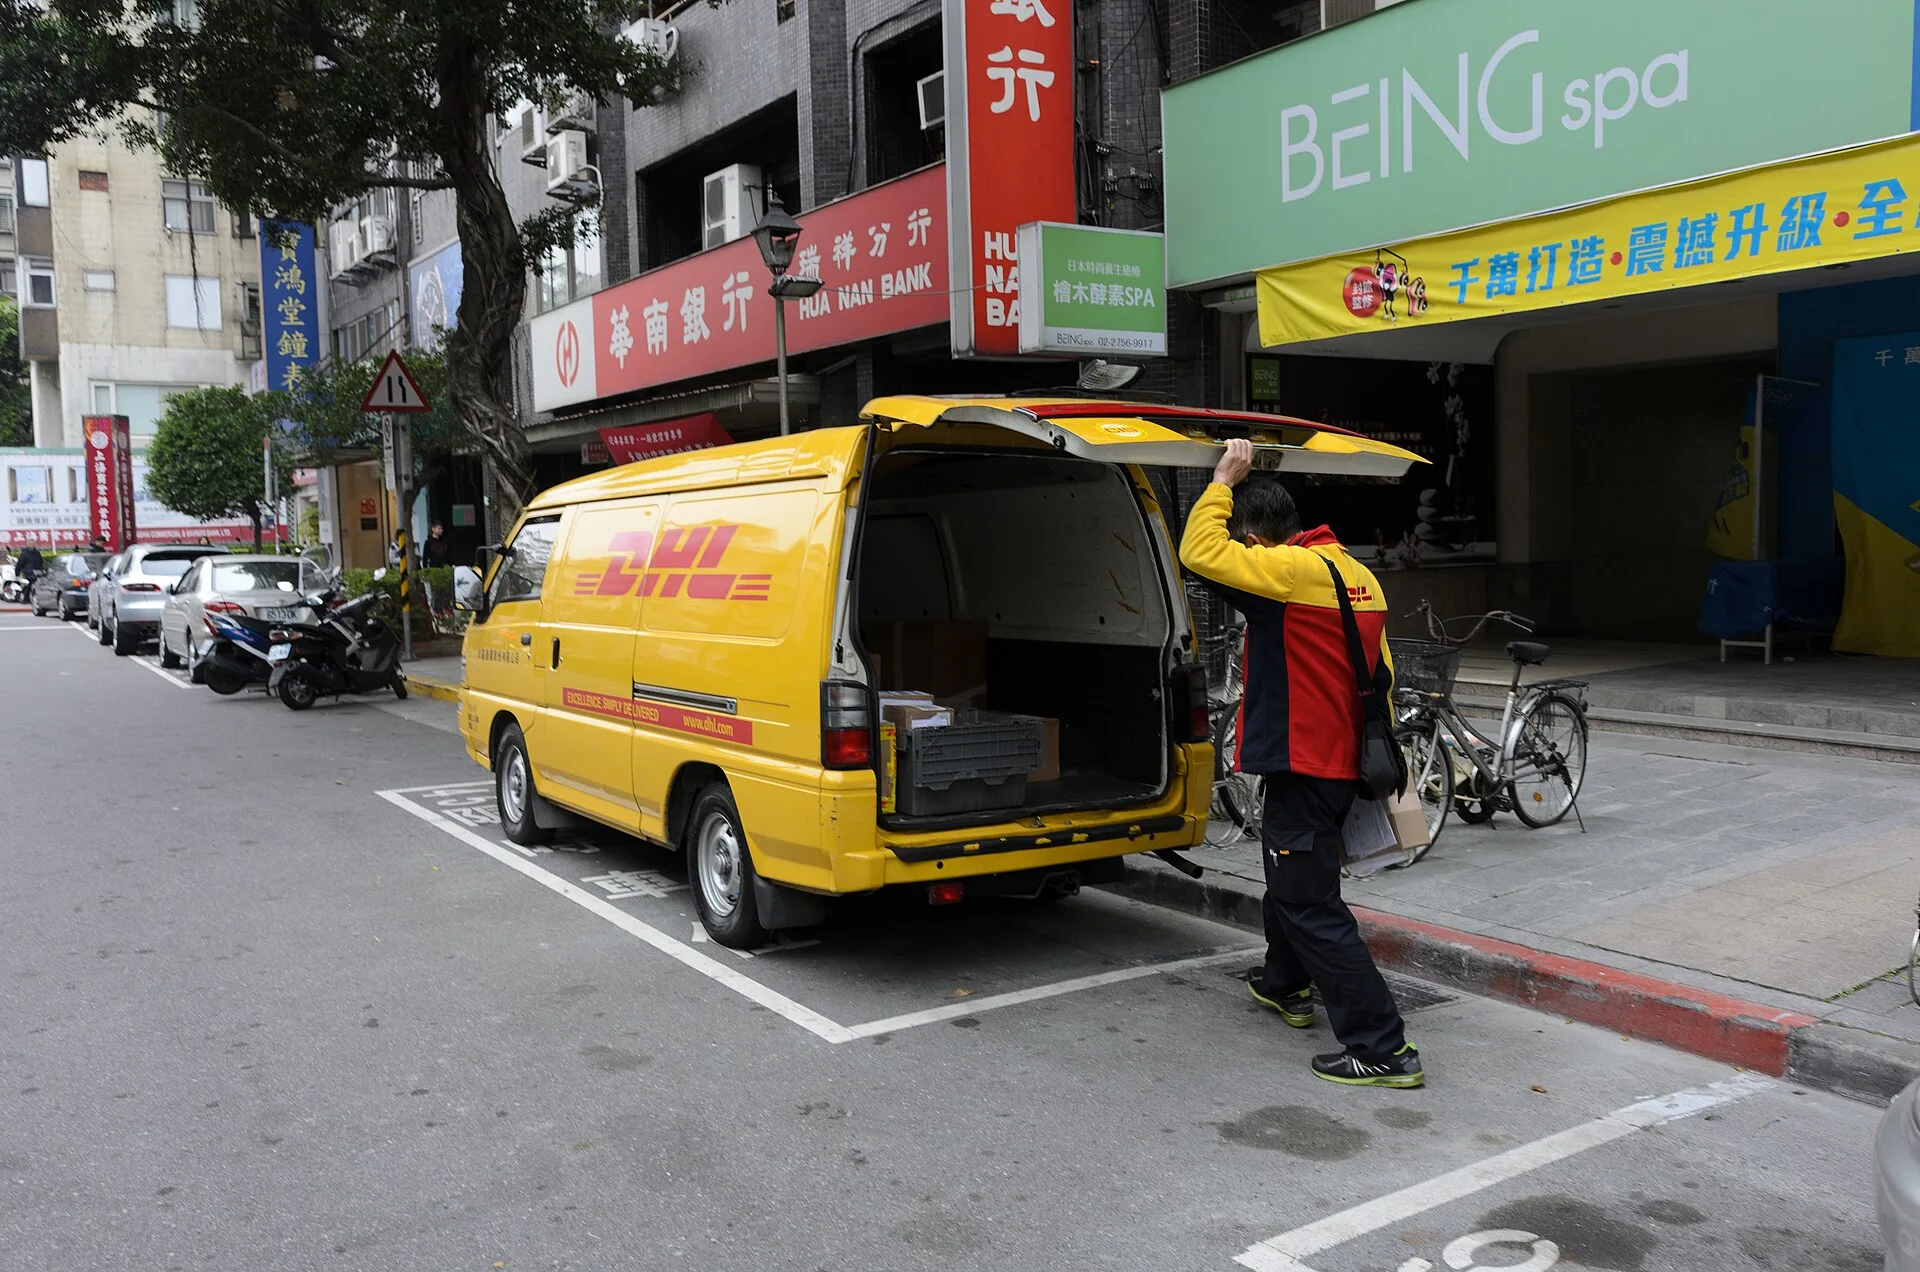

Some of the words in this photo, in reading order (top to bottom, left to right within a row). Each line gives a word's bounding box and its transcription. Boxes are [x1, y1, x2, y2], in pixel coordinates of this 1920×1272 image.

[1281, 29, 1542, 203] BEING
[1561, 49, 1688, 148] spa
[799, 208, 932, 280] 瑞祥分行
[985, 231, 1017, 260] HU
[1448, 235, 1605, 304] 千萬打造
[1626, 192, 1827, 276] 震撼升級
[1853, 178, 1920, 240] 全
[800, 299, 831, 321] HUA
[839, 278, 873, 311] NAN
[882, 262, 932, 300] BANK
[985, 264, 1018, 294] NA
[1053, 280, 1155, 307] 檜木酵素SPA
[609, 271, 754, 370] 華南銀行
[986, 298, 1019, 327] BA
[1057, 333, 1083, 345] BEING
[1098, 337, 1153, 348] 02-2756-9917
[596, 525, 738, 600] DHL
[683, 715, 733, 737] www.dhl.com
